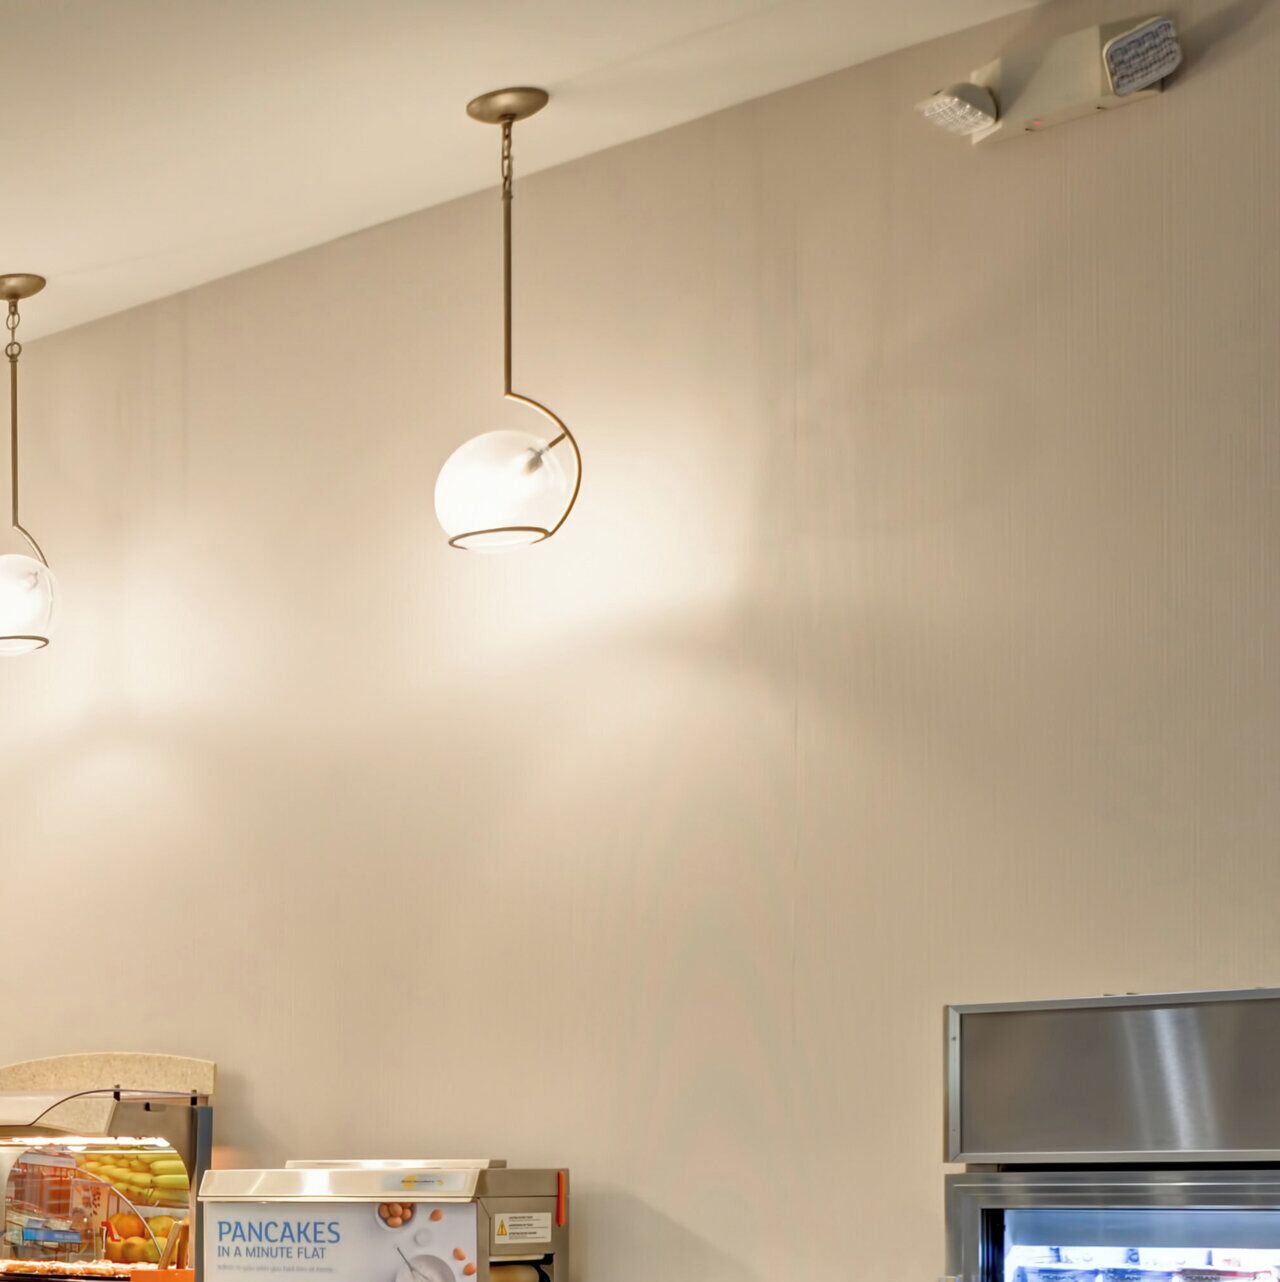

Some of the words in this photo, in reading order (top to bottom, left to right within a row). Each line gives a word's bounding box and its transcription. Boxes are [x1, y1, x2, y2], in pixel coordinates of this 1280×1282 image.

[217, 1221, 341, 1244] PANCAKES
[217, 1245, 230, 1258] IN
[234, 1246, 242, 1258] A
[245, 1246, 293, 1259] MINUTE
[297, 1247, 327, 1260] FLAT
